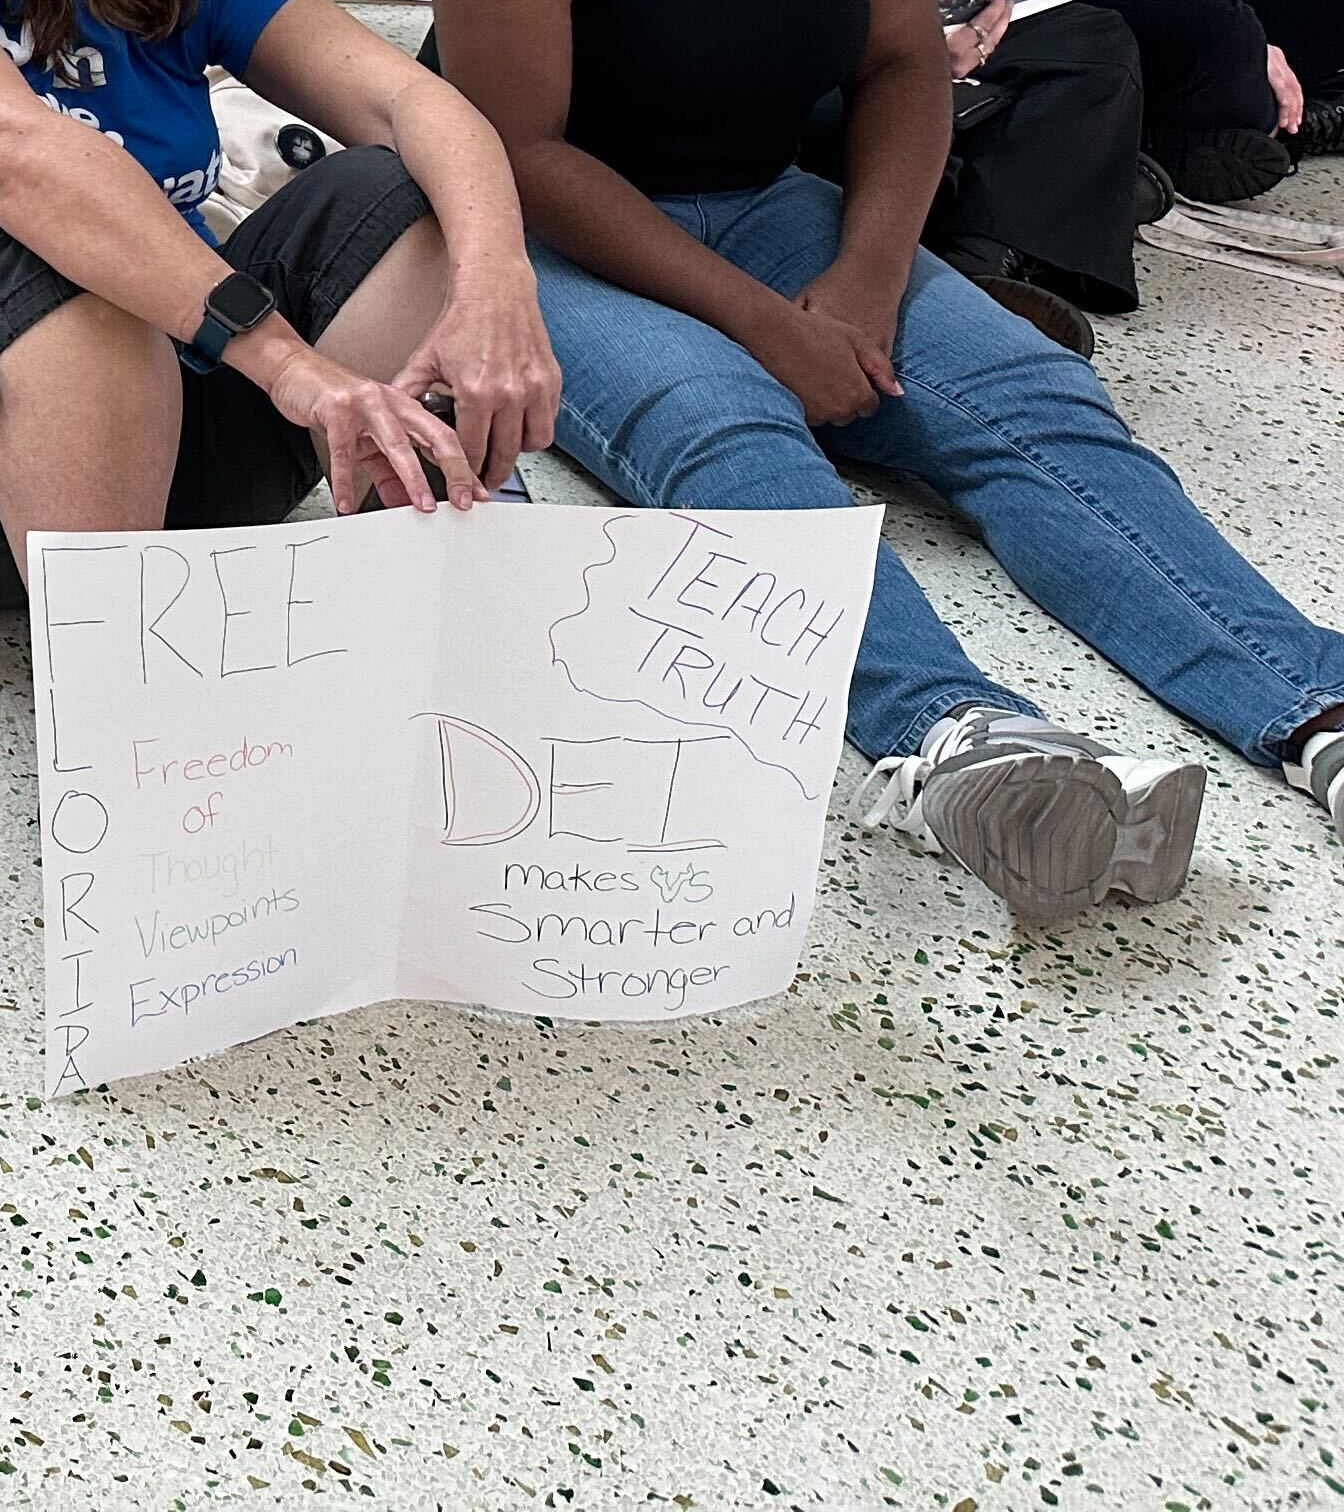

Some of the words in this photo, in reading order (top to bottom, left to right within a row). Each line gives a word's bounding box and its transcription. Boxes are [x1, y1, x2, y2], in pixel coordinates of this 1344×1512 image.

[41, 535, 349, 686] FREE
[647, 511, 845, 665] TEACH
[628, 606, 829, 745] TRUTH
[133, 736, 294, 789] Freedom
[409, 712, 732, 853] DEI
[182, 792, 224, 835] of
[143, 834, 280, 896] Thought
[504, 863, 640, 893] makes
[133, 886, 301, 959] Viewpoints
[468, 902, 718, 947] Smarter
[733, 892, 795, 937] and
[127, 944, 299, 1028] Expression
[521, 958, 731, 1011] Stronger
